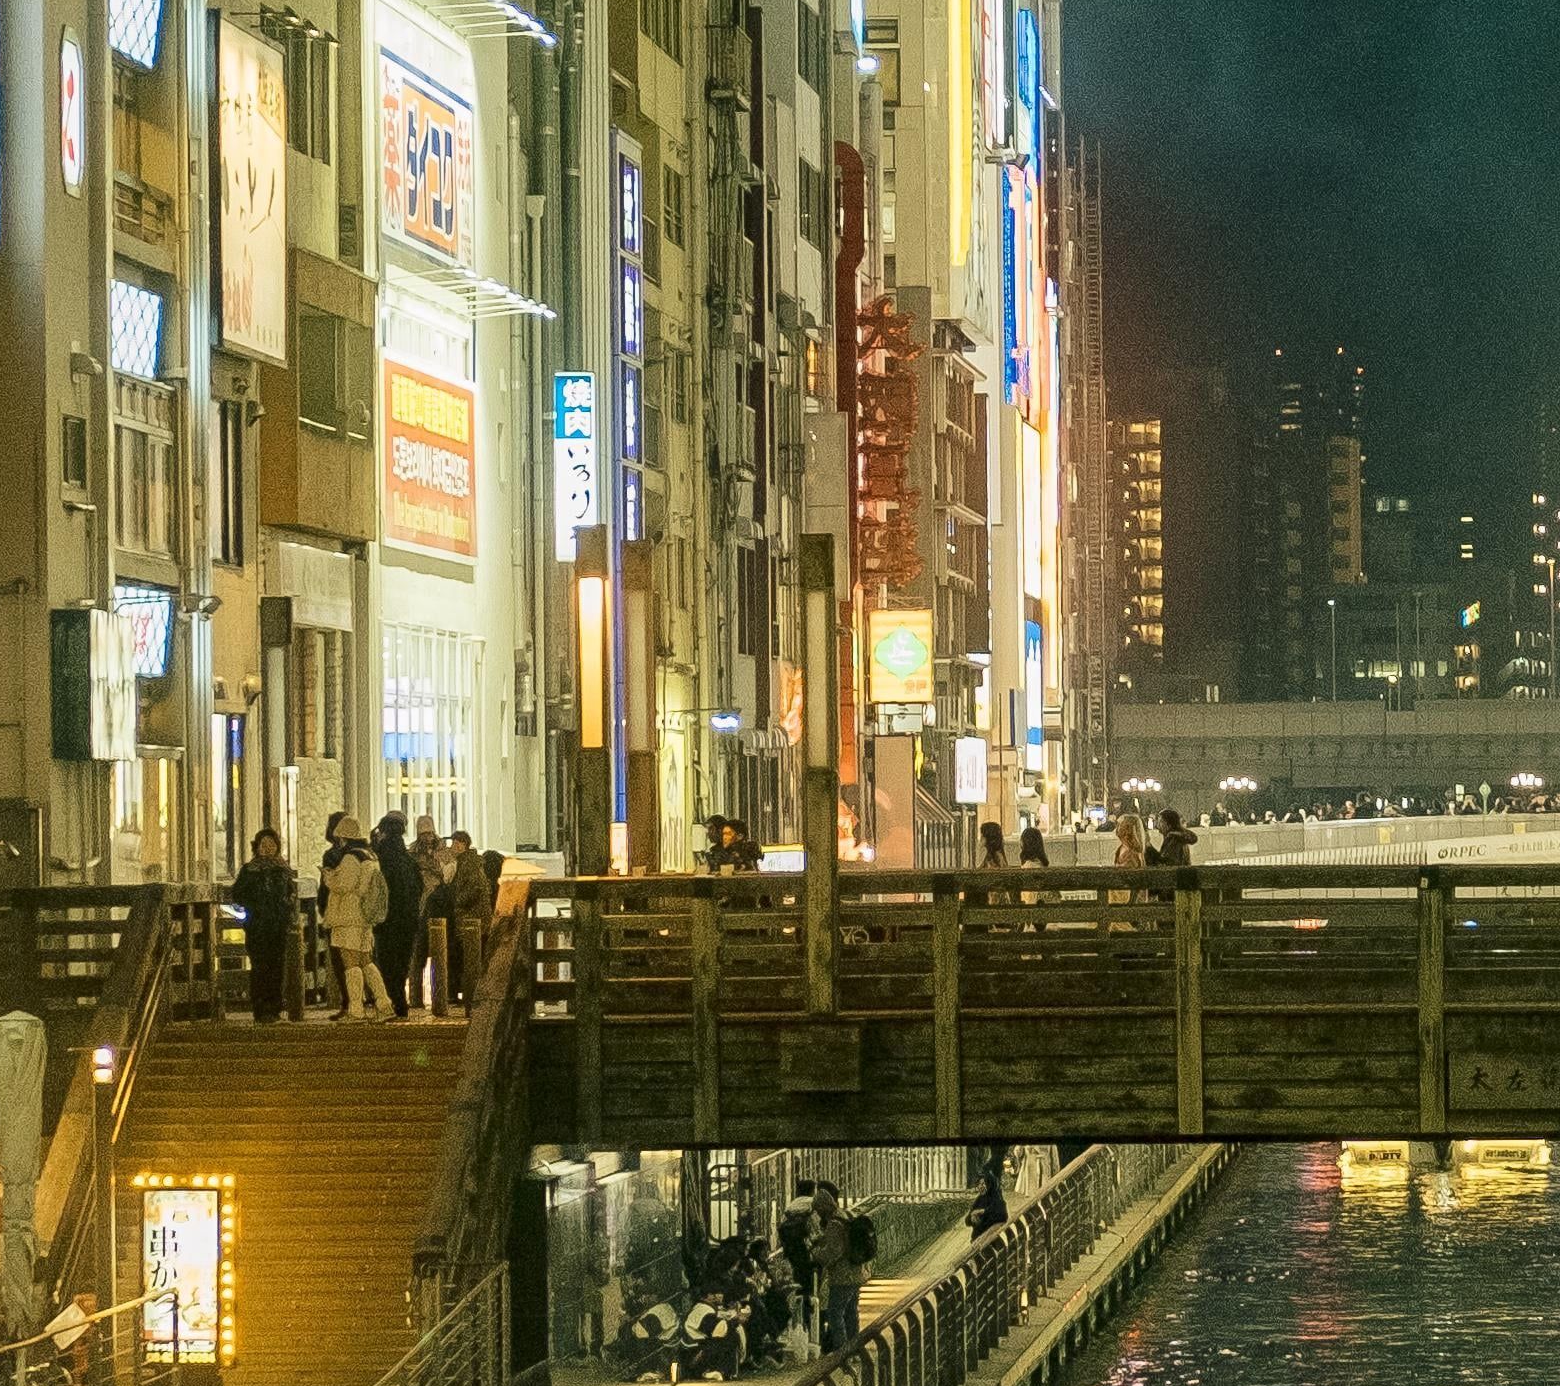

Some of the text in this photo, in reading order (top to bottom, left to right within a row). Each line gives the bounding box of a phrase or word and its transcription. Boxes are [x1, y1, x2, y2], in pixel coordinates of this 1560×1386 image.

[562, 378, 592, 519] 焼肉 いろり
